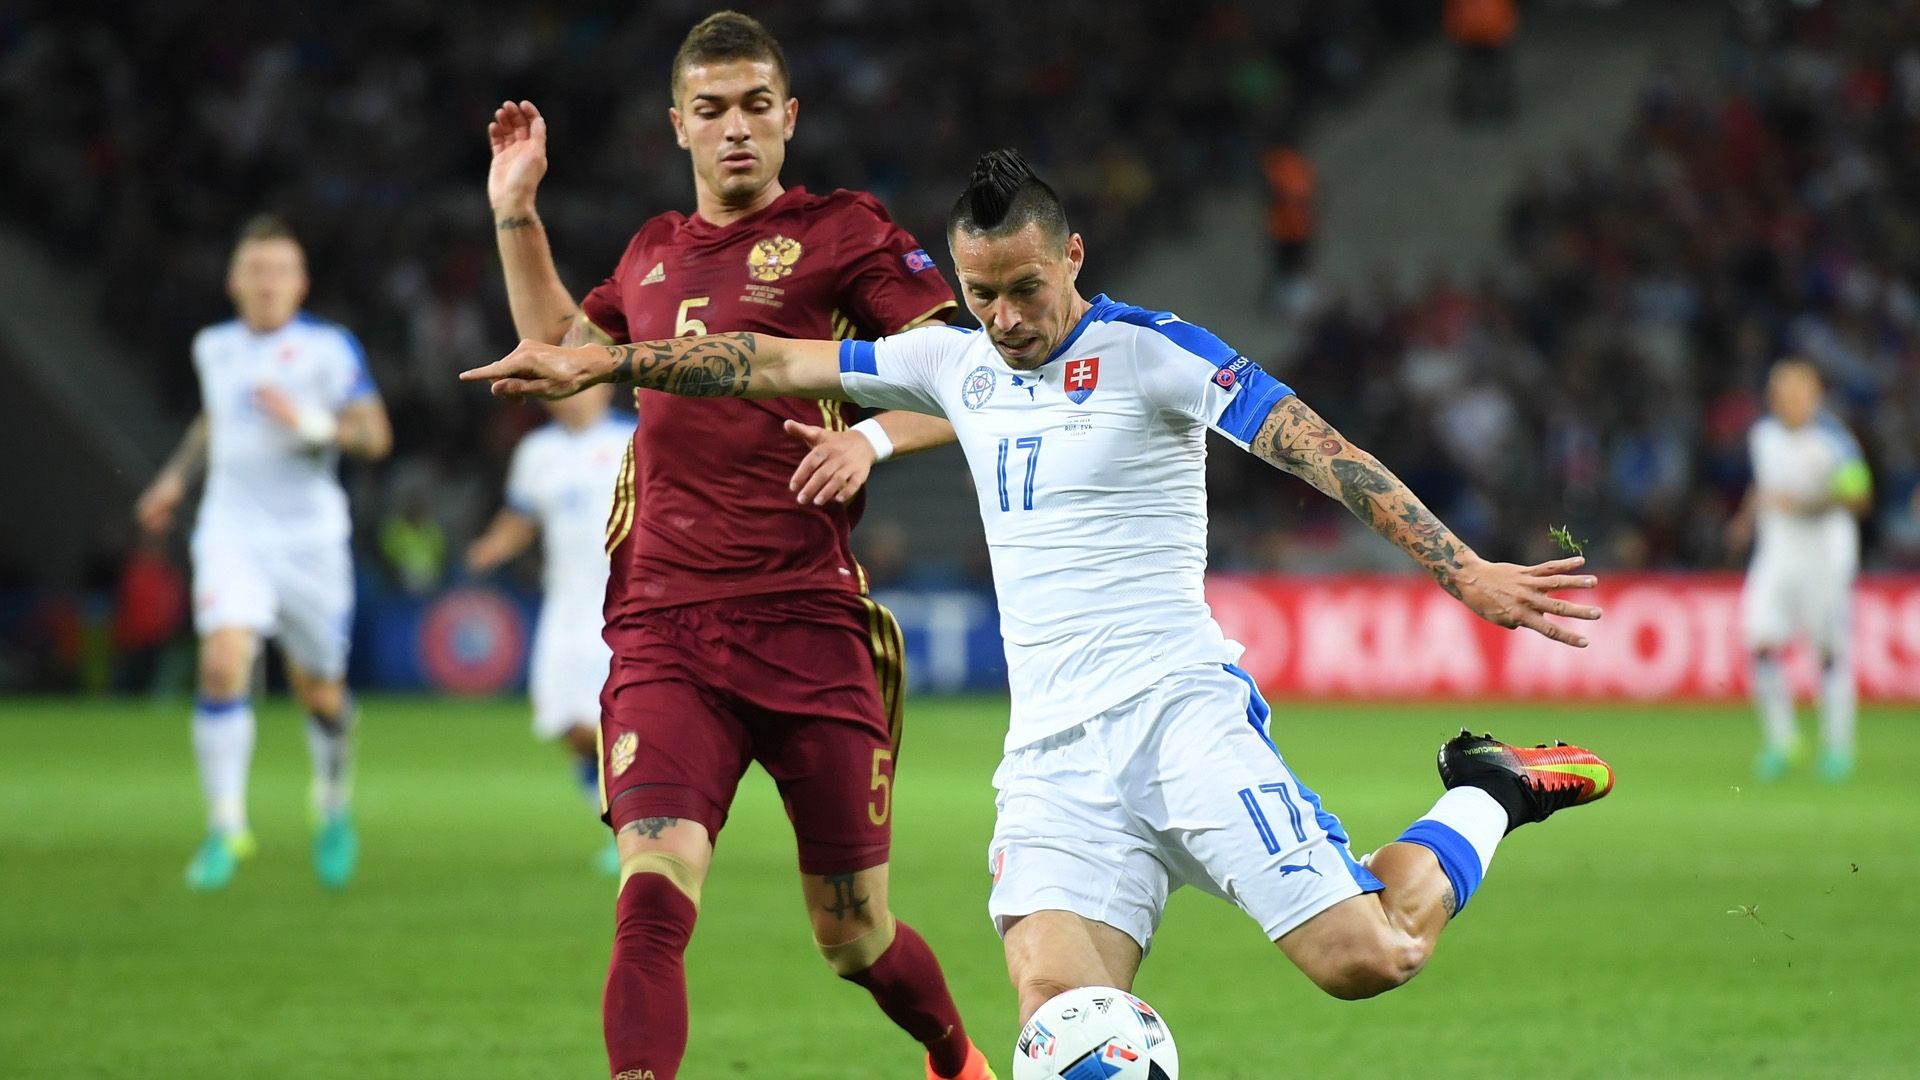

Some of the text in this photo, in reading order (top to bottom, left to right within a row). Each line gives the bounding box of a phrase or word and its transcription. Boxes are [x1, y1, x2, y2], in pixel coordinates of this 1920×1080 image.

[674, 297, 711, 337] 5
[996, 436, 1042, 512] 17
[1300, 583, 1920, 696] KIA MOTRS
[868, 748, 893, 825] 5
[1237, 782, 1308, 856] 17
